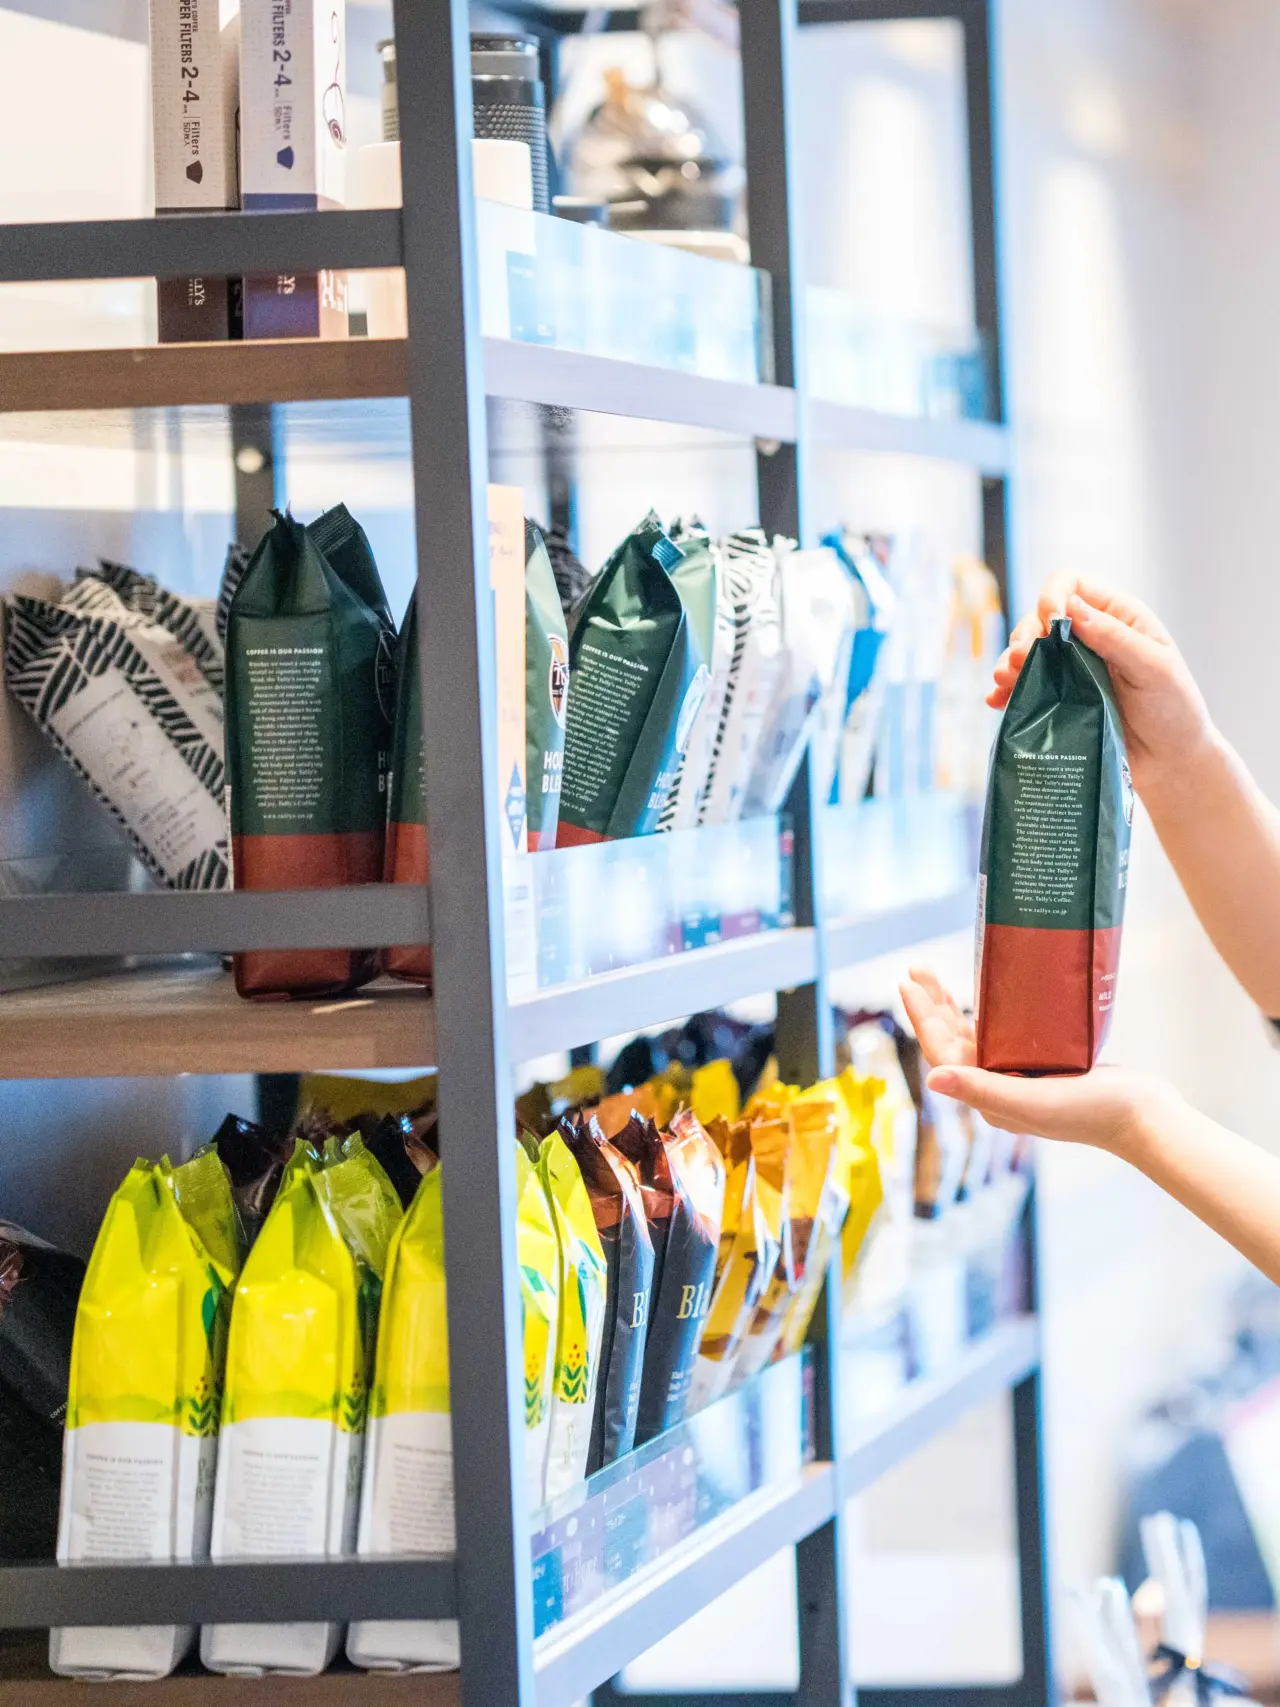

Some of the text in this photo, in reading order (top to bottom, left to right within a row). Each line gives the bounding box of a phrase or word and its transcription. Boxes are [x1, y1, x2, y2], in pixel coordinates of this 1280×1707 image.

[180, 23, 192, 63] FILTERS
[272, 5, 292, 87] FILTERS 2-4
[180, 66, 200, 102] 2-4
[191, 121, 200, 156] Filters
[582, 644, 602, 655] COFFEE
[623, 659, 649, 672] PASSION
